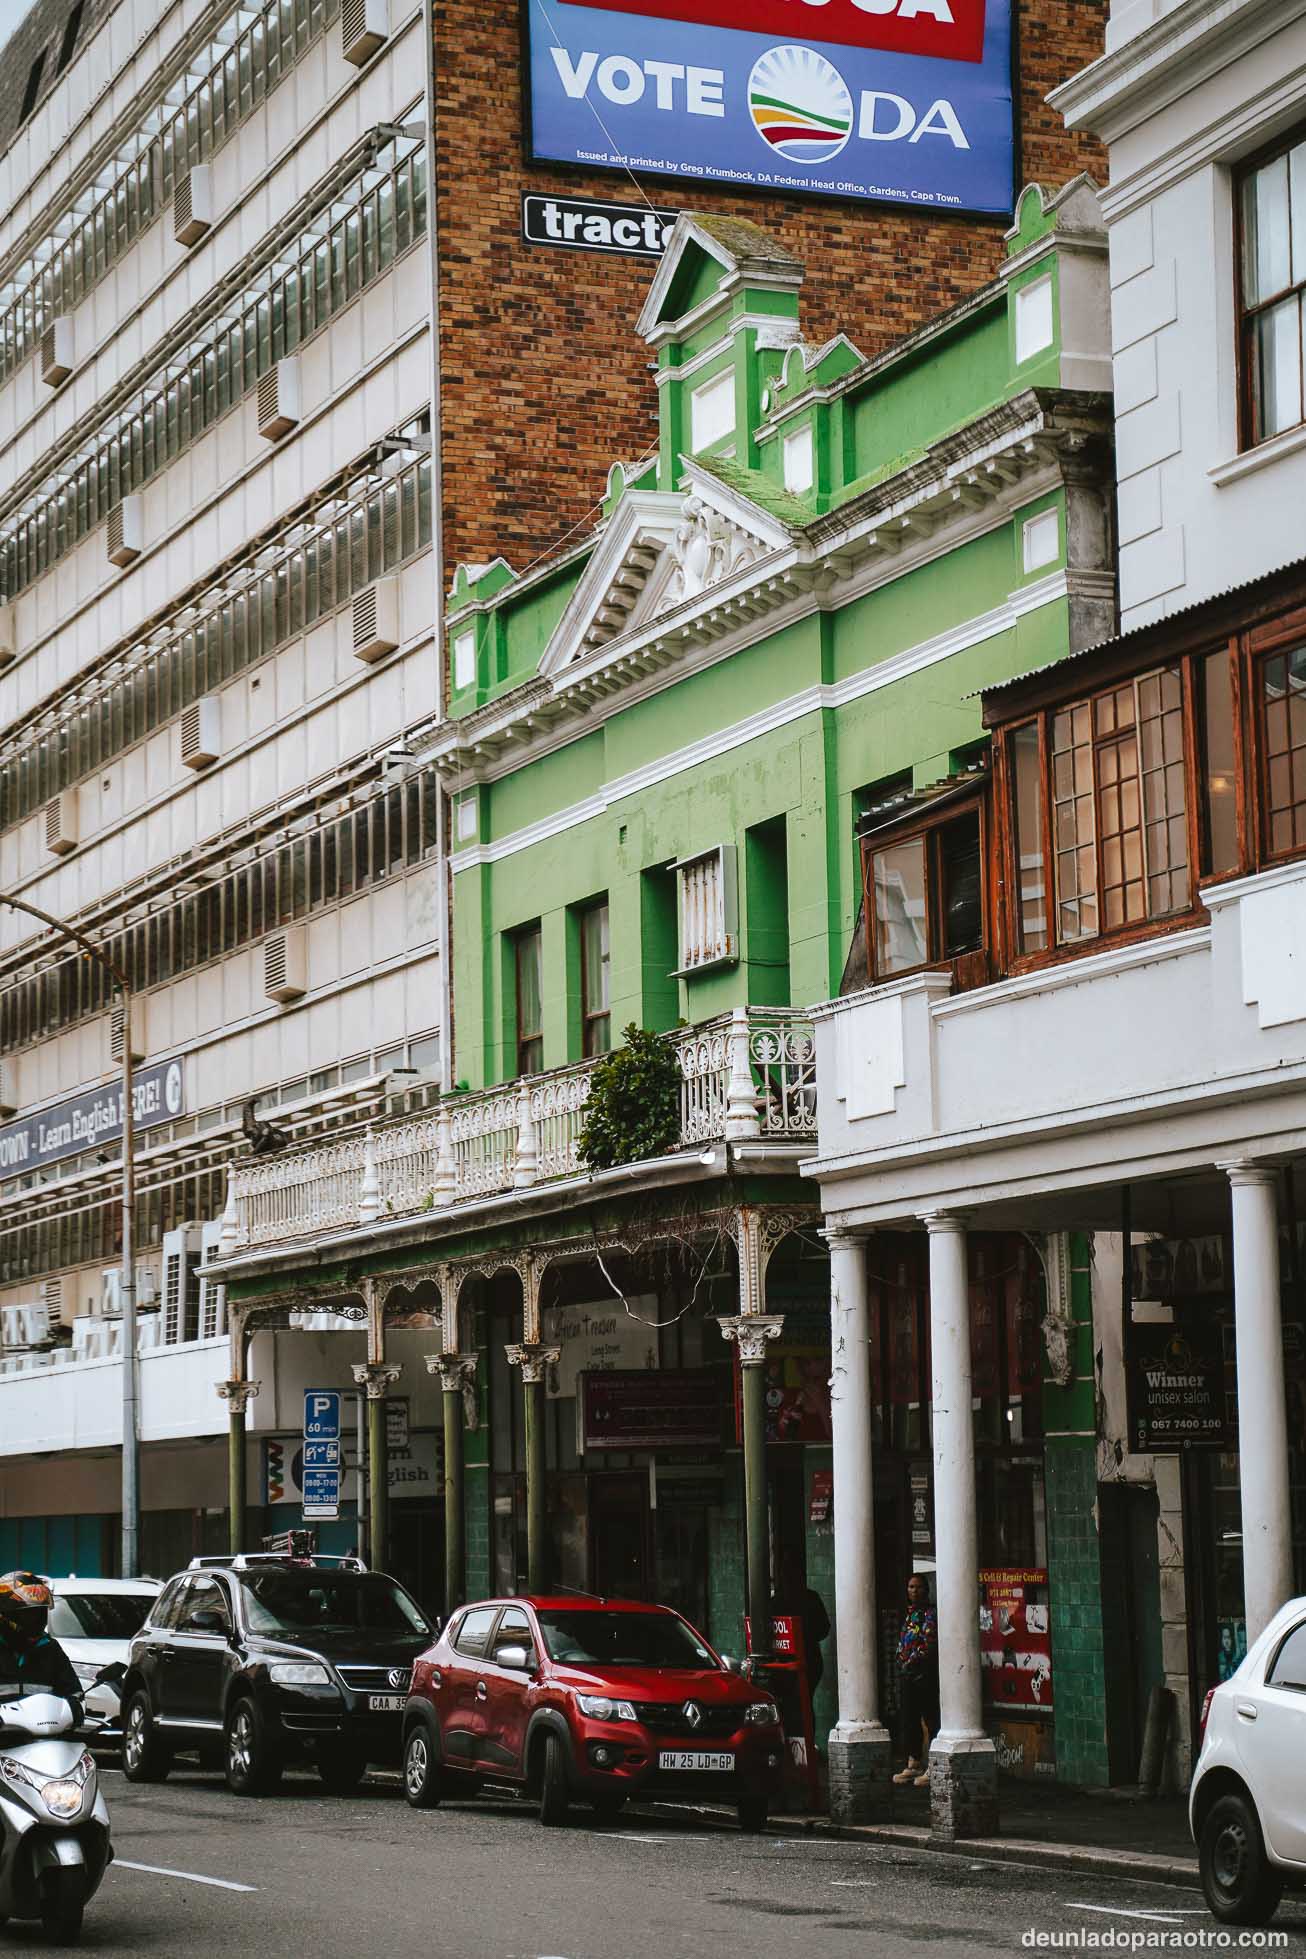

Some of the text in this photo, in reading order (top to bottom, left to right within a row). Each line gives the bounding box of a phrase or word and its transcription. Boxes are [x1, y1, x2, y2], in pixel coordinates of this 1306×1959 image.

[550, 47, 970, 150] VOTE DA
[576, 150, 962, 204] Issued and printed by Greg Krumbock, DA Federal Head Office, Gardens, Cape Town.
[39, 1122, 72, 1154] Learn
[72, 1097, 118, 1144] English
[1146, 1370, 1205, 1388] Winner
[1148, 1390, 1210, 1405] unisex salon
[313, 1397, 331, 1418] P
[308, 1422, 321, 1433] 60
[1174, 1419, 1200, 1429] 7400
[1202, 1419, 1222, 1429] 100
[385, 1465, 430, 1487] glish
[1002, 1572, 1022, 1584] Repair
[1022, 1572, 1044, 1582] Center
[372, 1697, 390, 1710] CAA
[680, 1754, 694, 1768] 25
[697, 1755, 711, 1769] LD
[719, 1755, 732, 1769] GP
